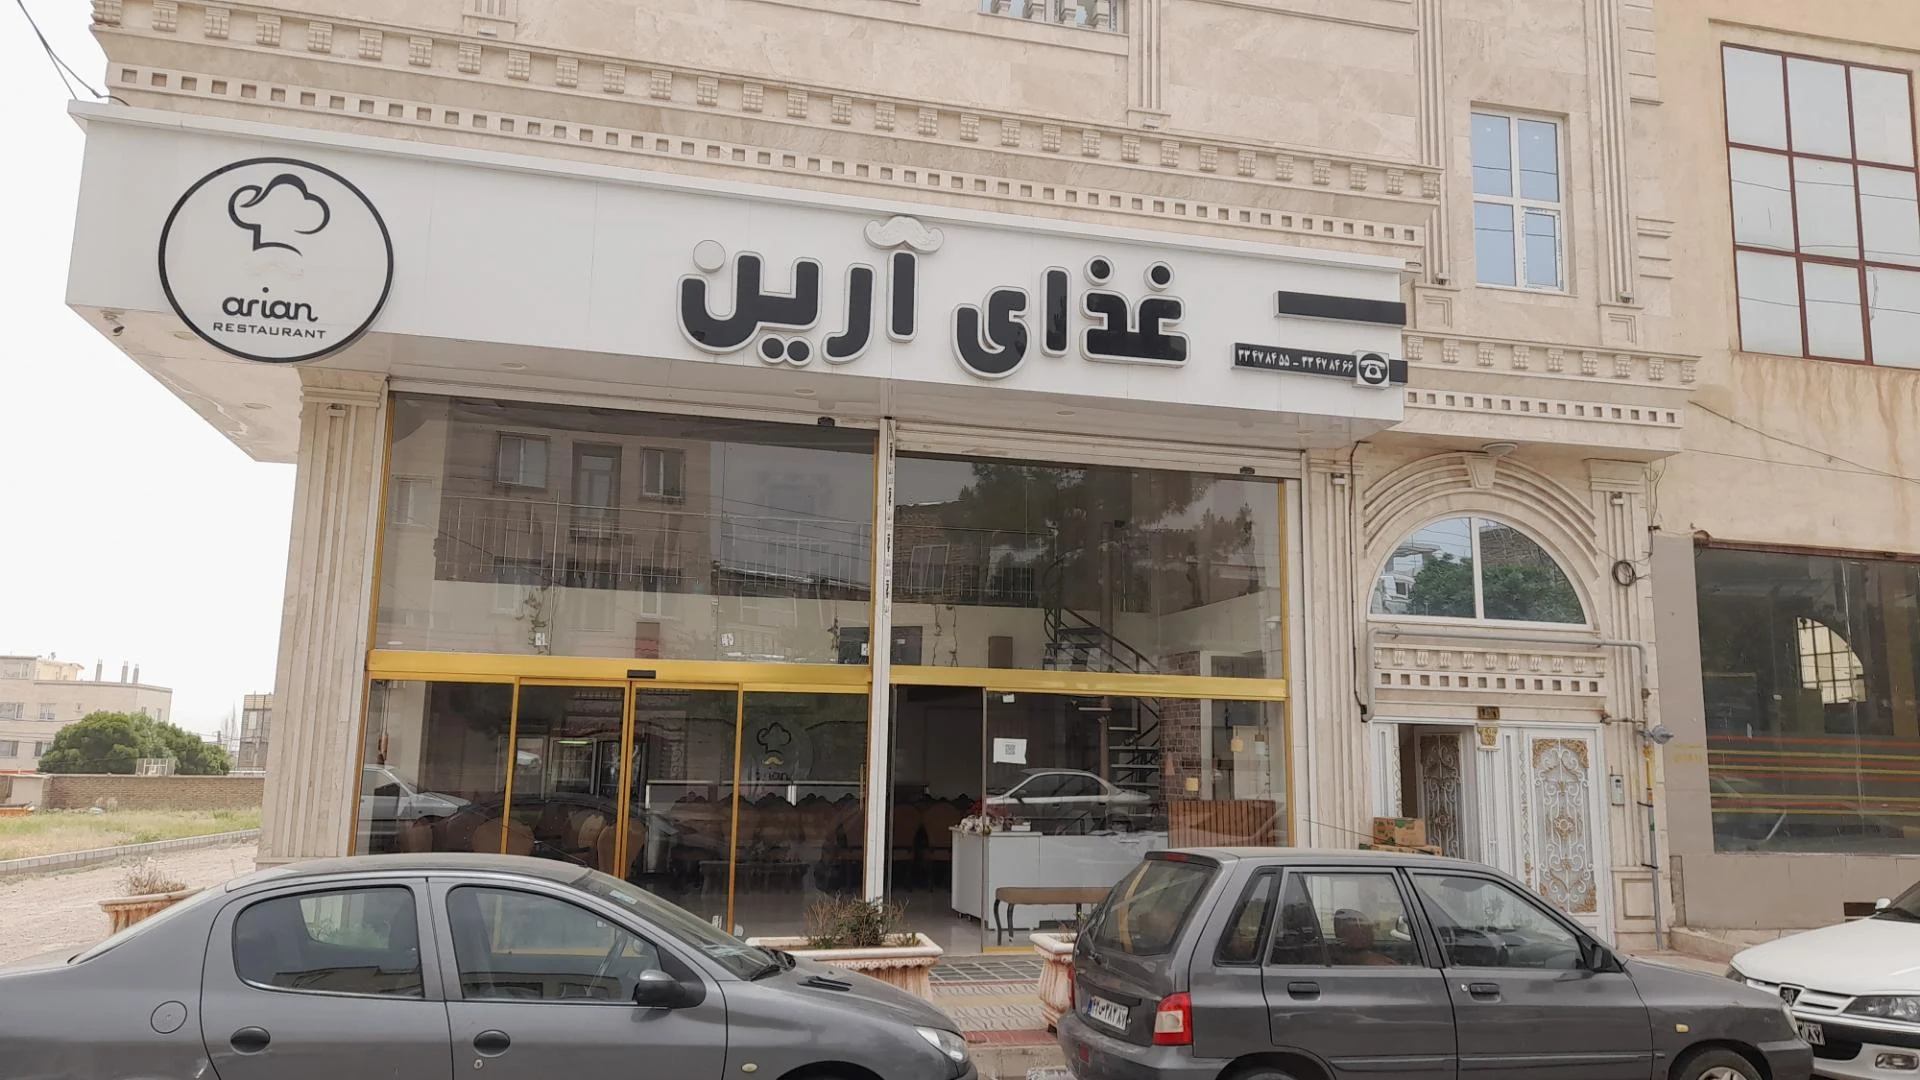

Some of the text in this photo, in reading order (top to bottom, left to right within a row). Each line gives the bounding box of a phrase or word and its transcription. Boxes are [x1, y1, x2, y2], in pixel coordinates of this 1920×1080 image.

[222, 287, 319, 322] arian
[679, 216, 1189, 376] غذای آرین
[213, 322, 327, 339] RESTAURANT
